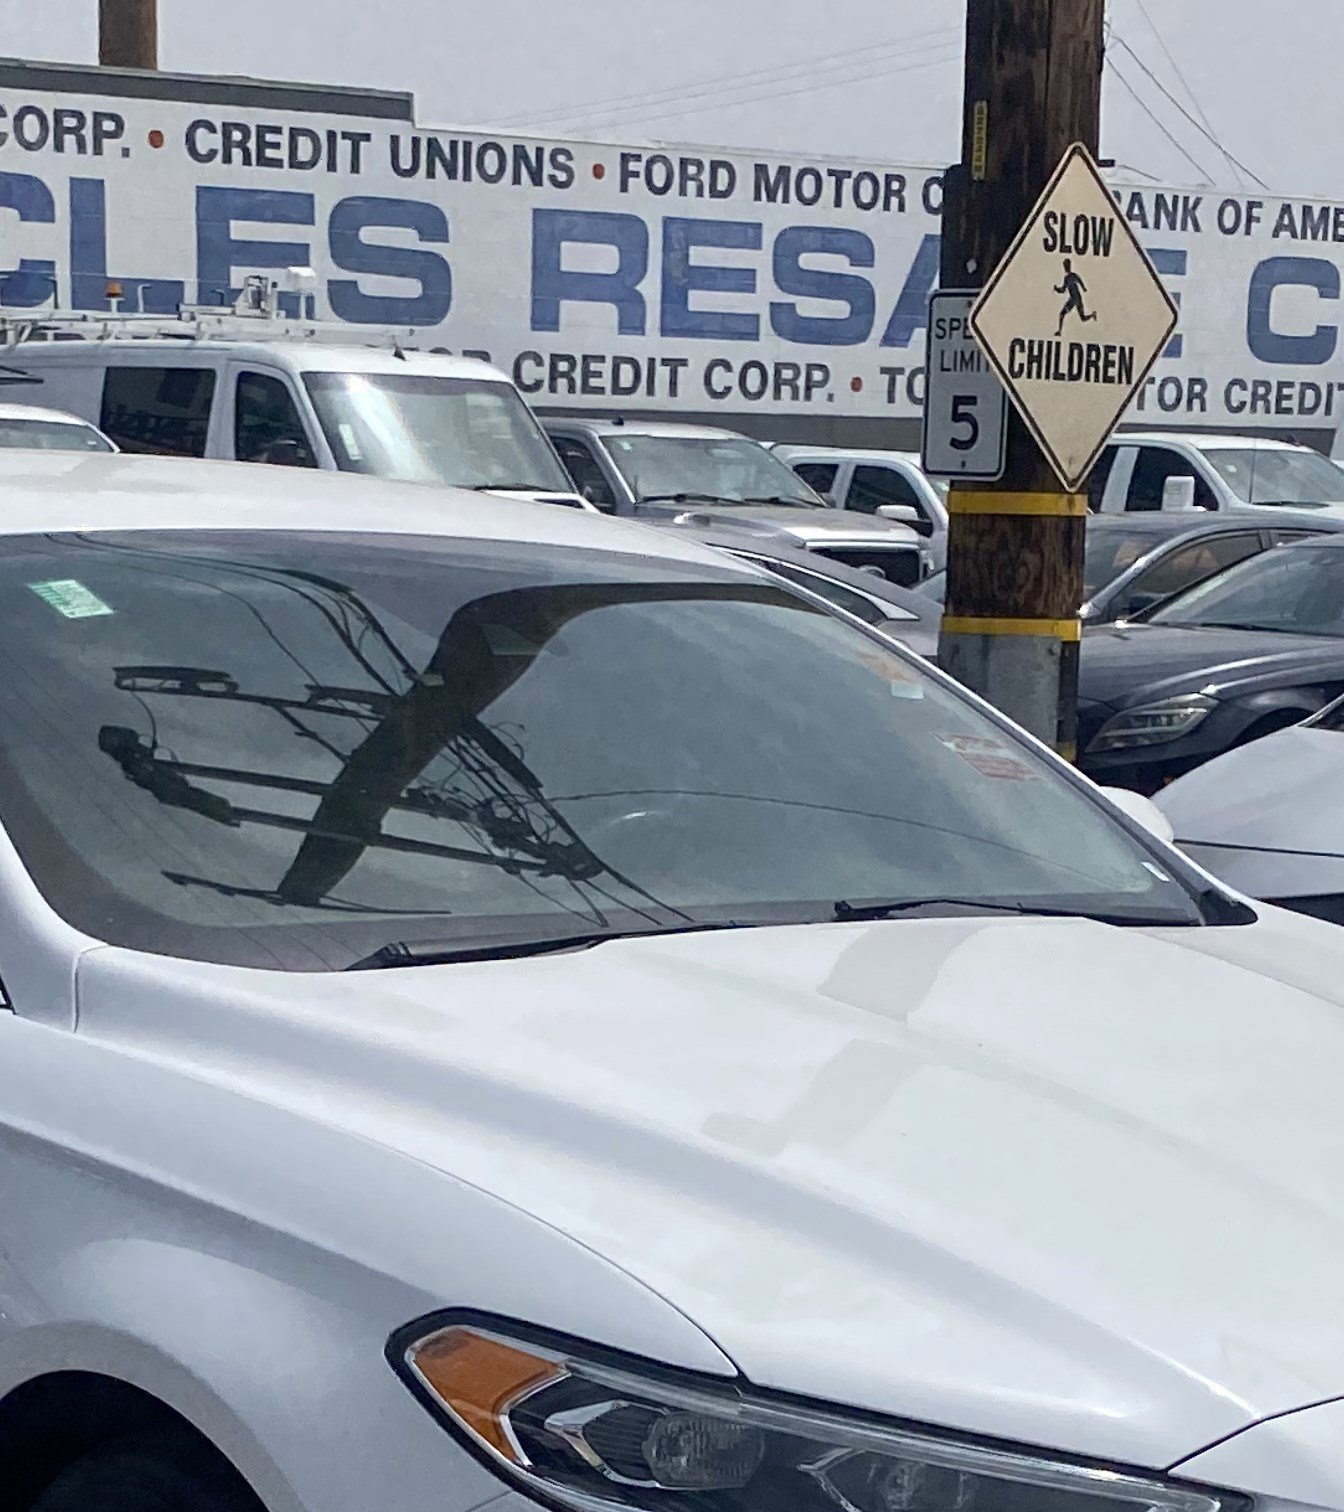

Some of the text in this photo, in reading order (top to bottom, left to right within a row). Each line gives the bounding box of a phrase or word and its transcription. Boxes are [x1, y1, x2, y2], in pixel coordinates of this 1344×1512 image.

[184, 118, 575, 190] CREDIT UNIONS
[619, 151, 737, 199] FORD
[753, 163, 907, 213] MOTOR
[1042, 210, 1115, 257] SLOW
[1113, 189, 1203, 233] ANK
[1217, 198, 1264, 236] OF
[935, 317, 975, 340] SPE
[511, 349, 690, 399] CREDIT
[703, 357, 835, 404] CORP.
[1007, 337, 1135, 386] CHILDREN
[1135, 375, 1208, 414] TOR
[949, 394, 980, 452] 5
